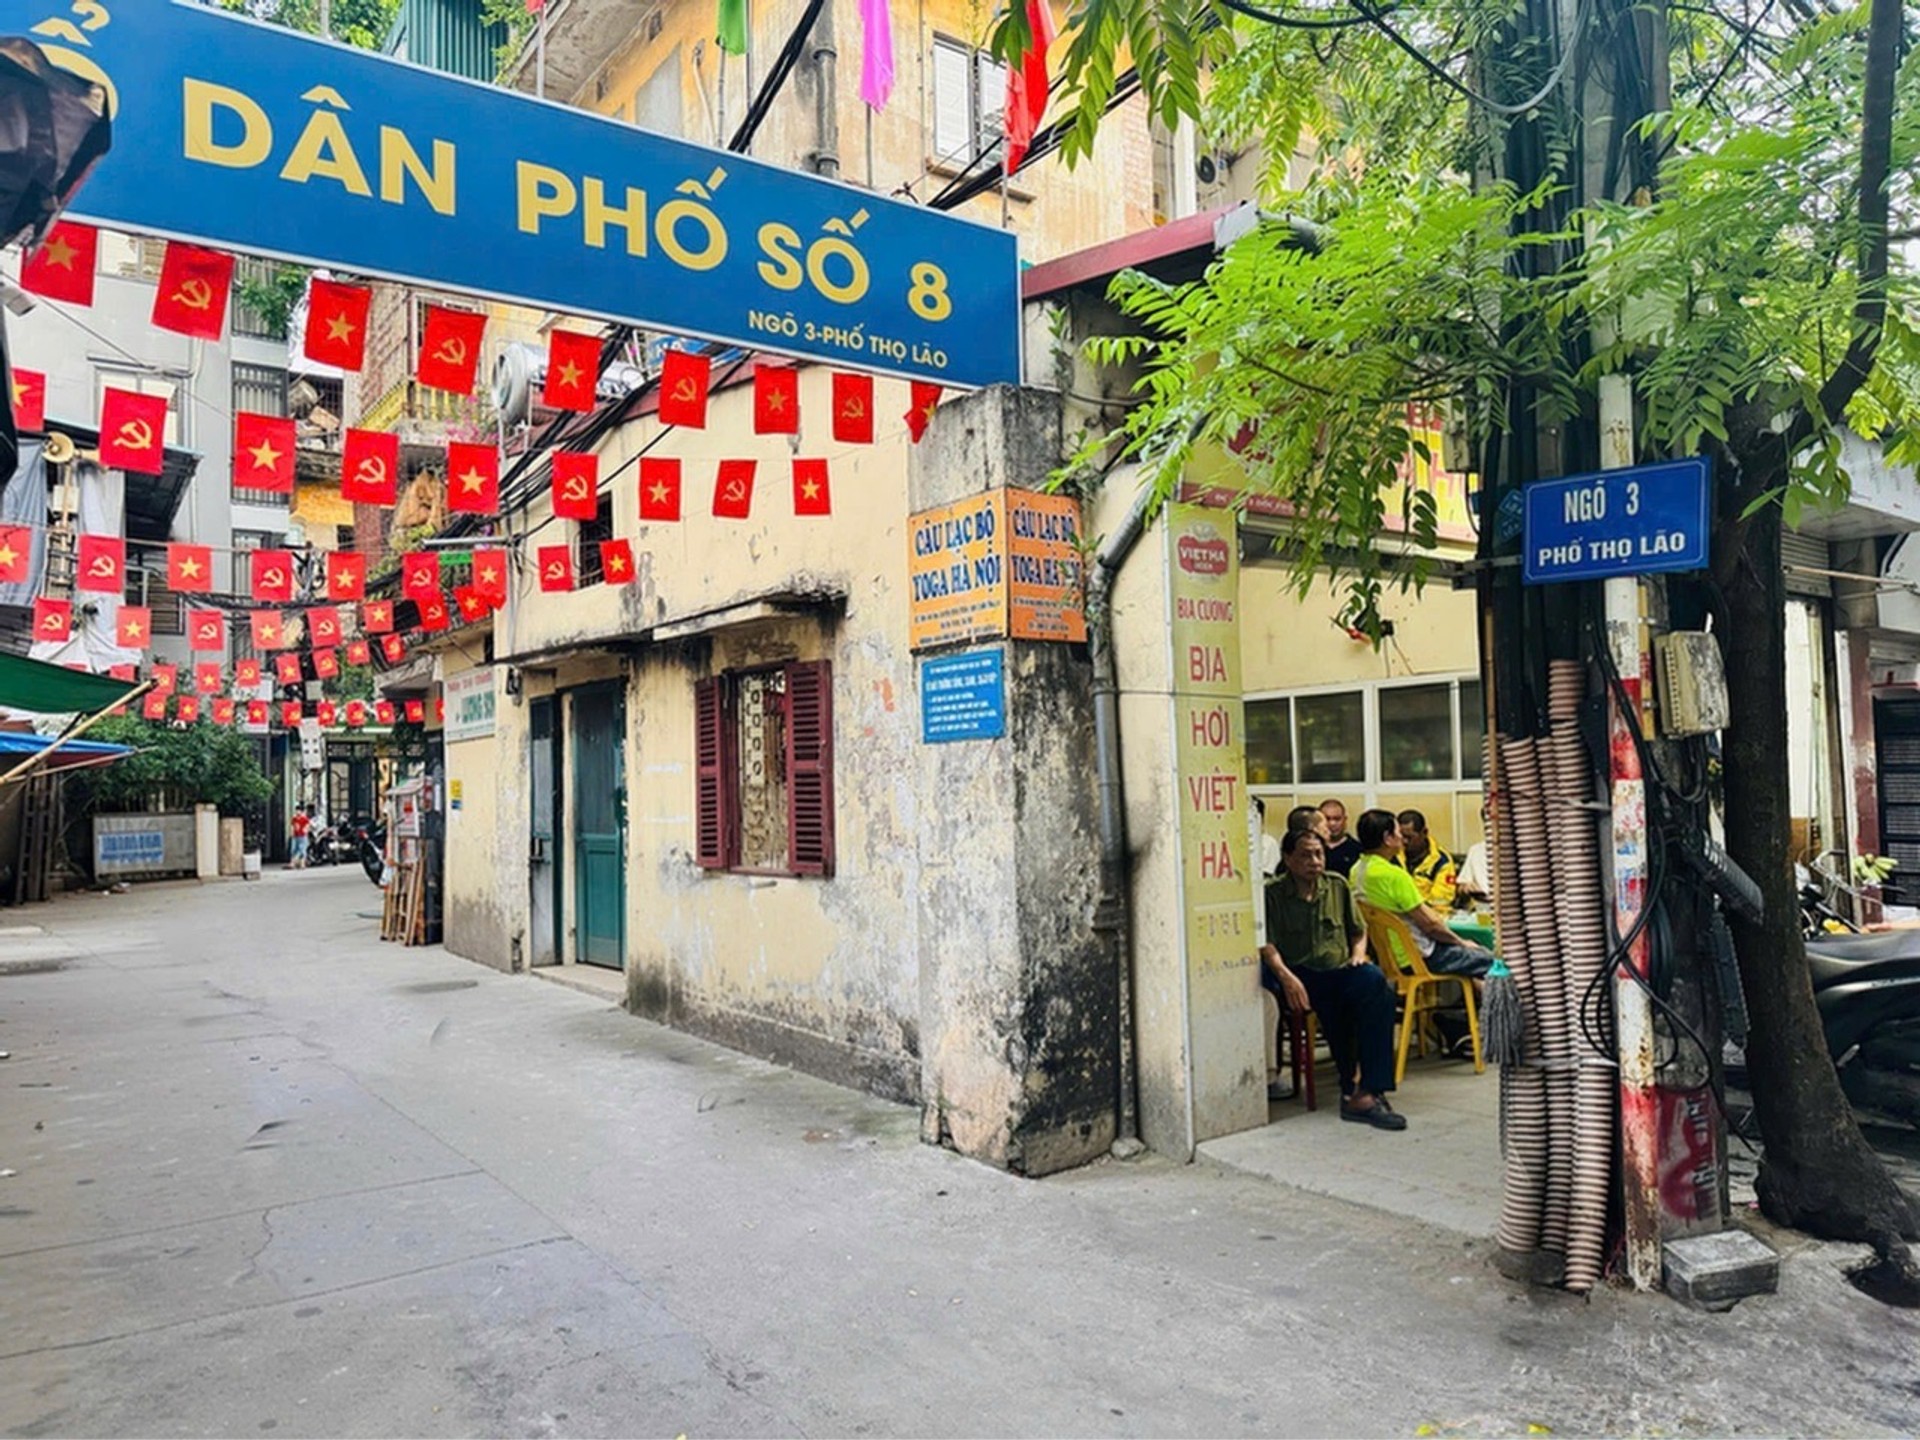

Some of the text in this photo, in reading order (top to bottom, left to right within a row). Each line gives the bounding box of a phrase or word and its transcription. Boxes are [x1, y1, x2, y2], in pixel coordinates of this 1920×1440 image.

[182, 77, 456, 216] DÂN
[516, 159, 729, 271] PHỐ
[756, 208, 871, 304] SỐ
[907, 262, 952, 321] 8
[748, 309, 799, 338] NGÕ
[869, 335, 907, 364] THỌ
[912, 342, 949, 369] LÃO
[1563, 479, 1607, 524] NGÕ
[1626, 481, 1640, 517] 3
[1011, 554, 1042, 586] YOGA
[1538, 529, 1686, 568] PHỐ THỌ LÃO
[912, 546, 1001, 602] YOGA HÀ NỘI
[1189, 645, 1228, 683] BIA
[1188, 765, 1238, 820] VIỆT
[1200, 830, 1234, 880] HÀ
